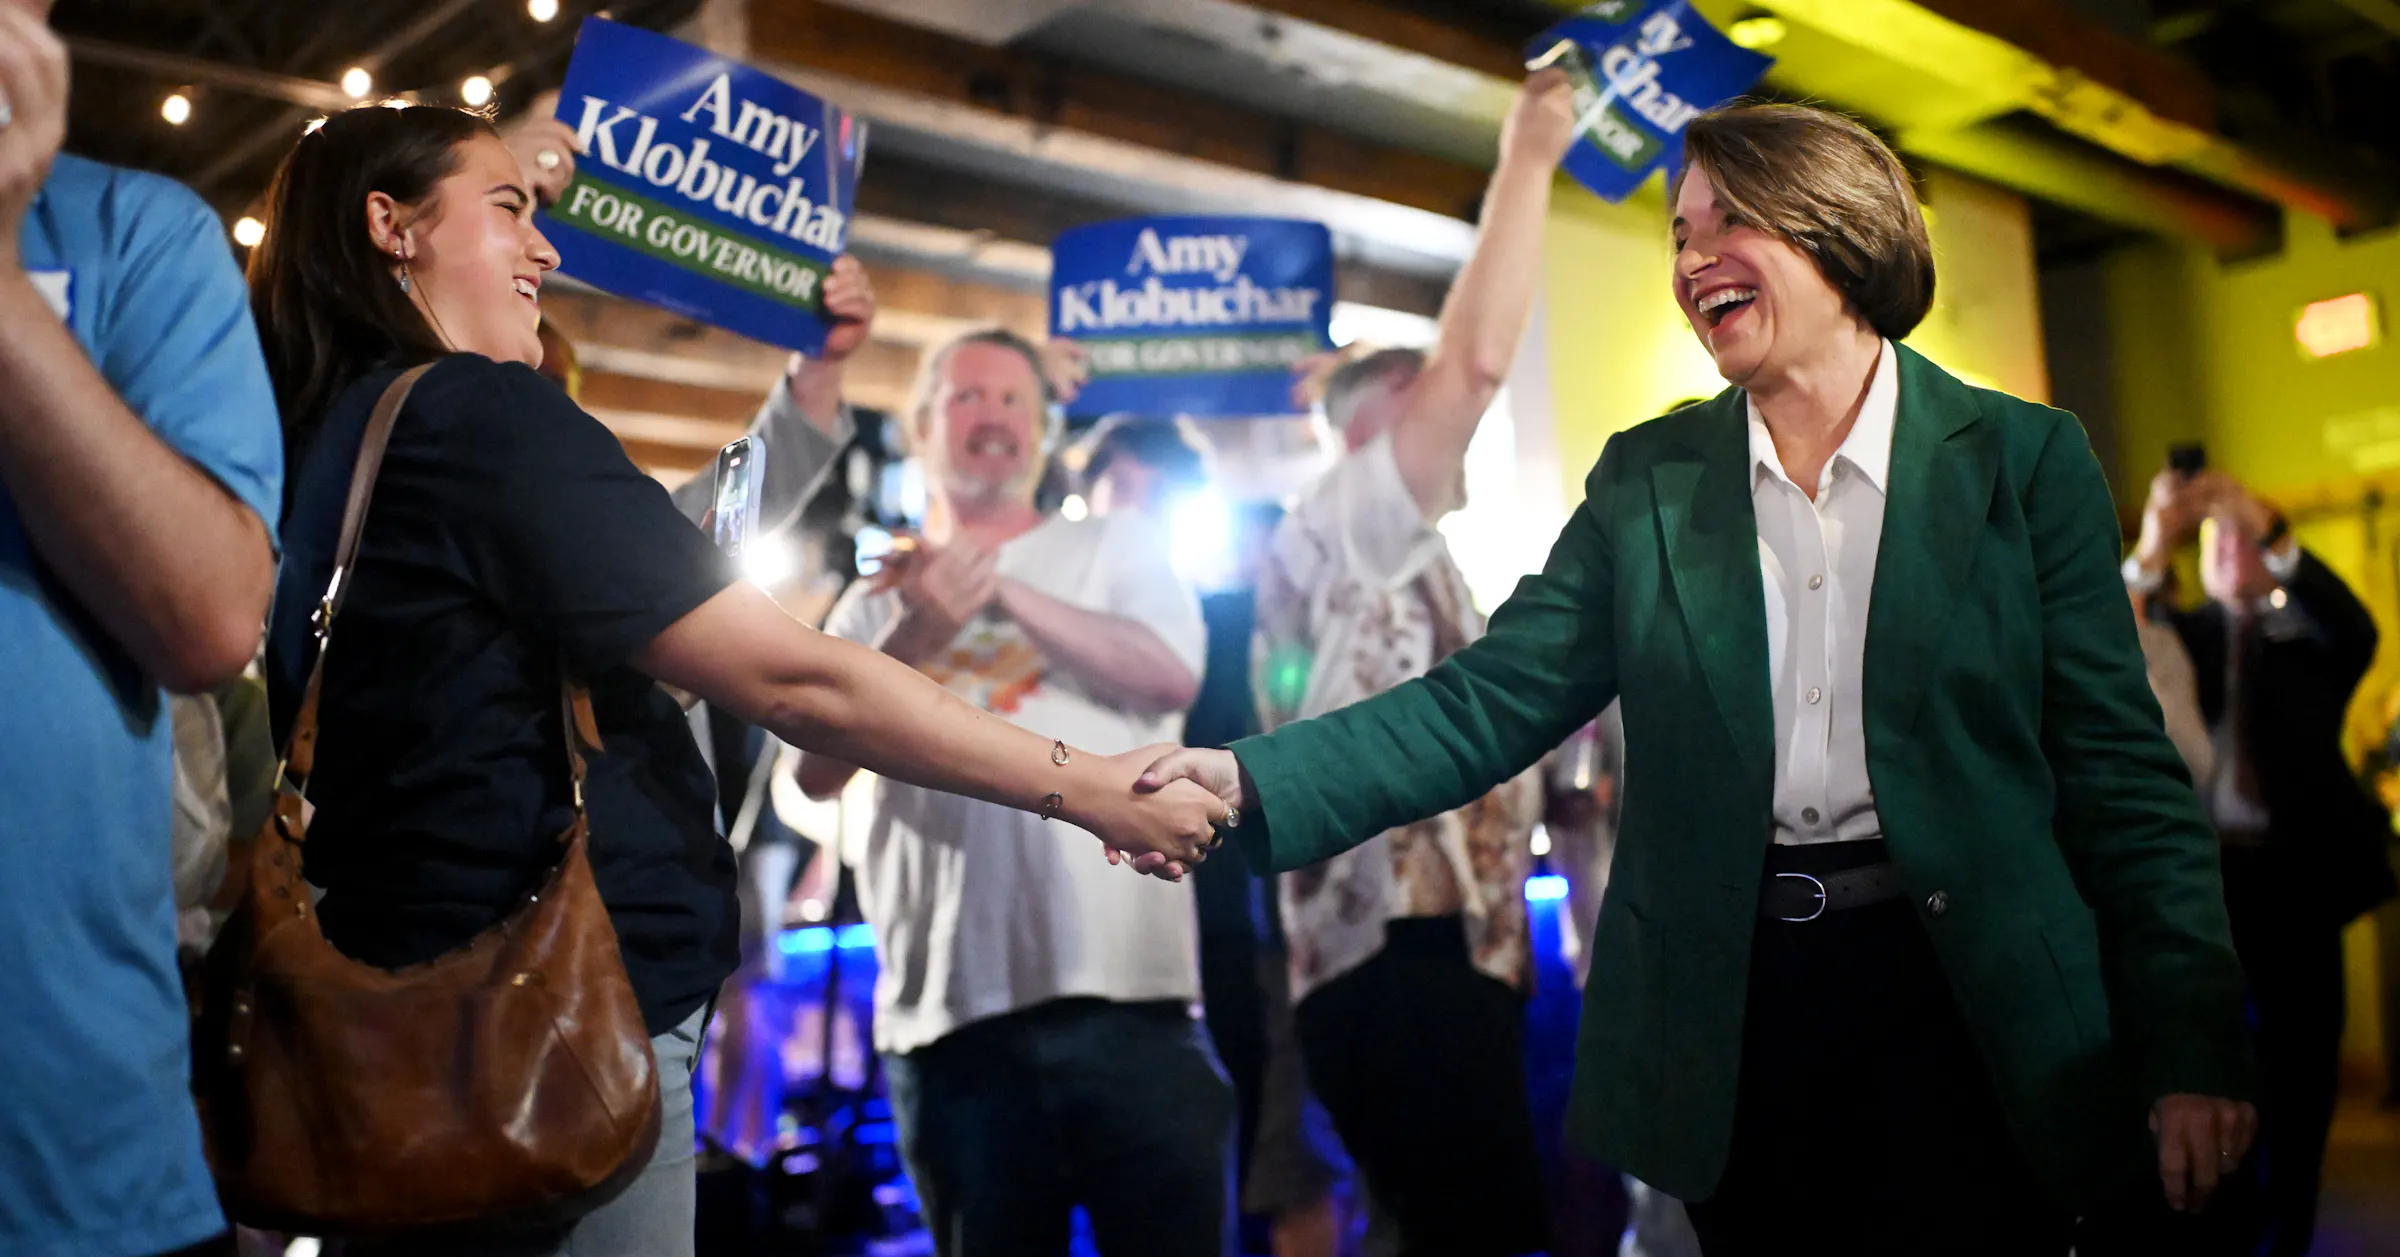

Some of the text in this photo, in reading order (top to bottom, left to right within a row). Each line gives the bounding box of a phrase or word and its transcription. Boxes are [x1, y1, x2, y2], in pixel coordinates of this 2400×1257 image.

[680, 72, 819, 177] Amy
[568, 184, 818, 301] FOR GOVERNOR
[1126, 226, 1248, 283] Amy
[1058, 275, 1321, 332] Klobuchar
